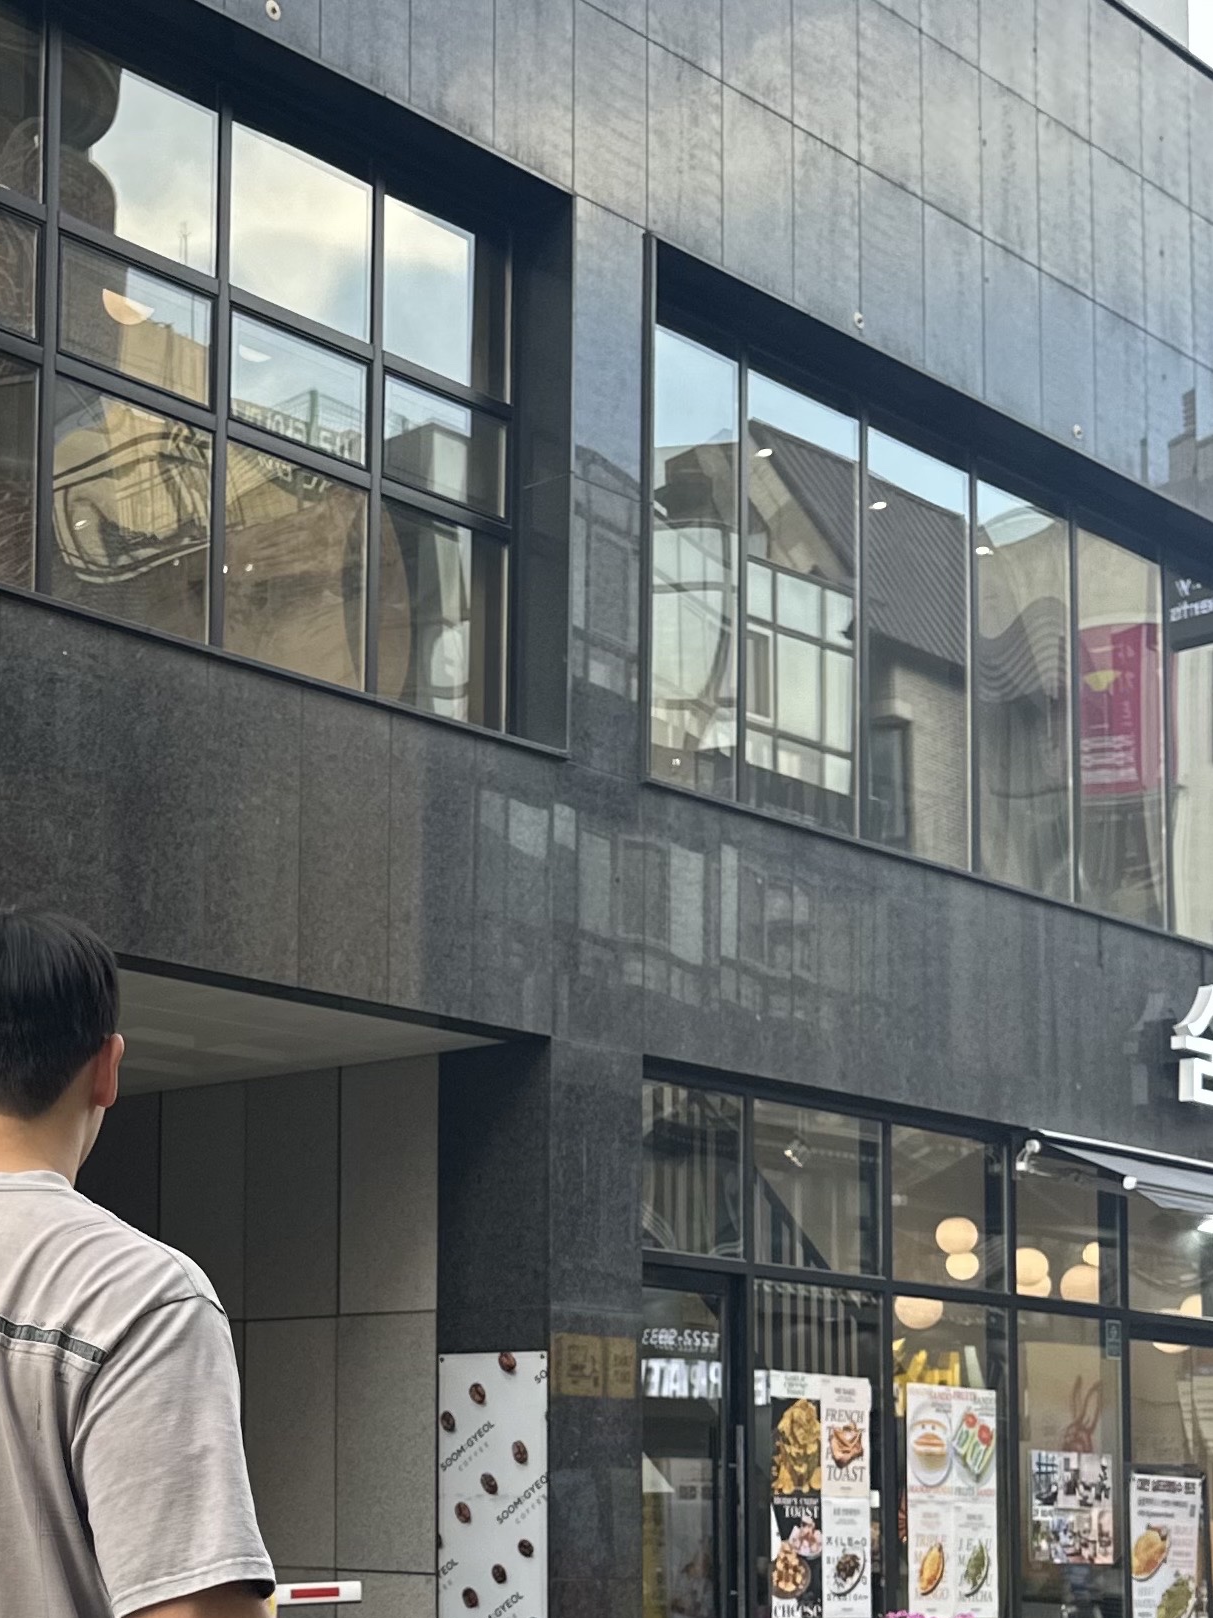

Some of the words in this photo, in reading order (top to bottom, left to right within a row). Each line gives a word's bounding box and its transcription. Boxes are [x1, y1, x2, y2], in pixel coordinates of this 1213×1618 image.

[826, 1408, 864, 1422] FRENCH
[440, 1445, 466, 1472] SOOM
[466, 1420, 495, 1447] GYEOL
[827, 1465, 866, 1482] TOAST
[496, 1497, 523, 1525] SOOM
[494, 1591, 524, 1618] GYEOL
